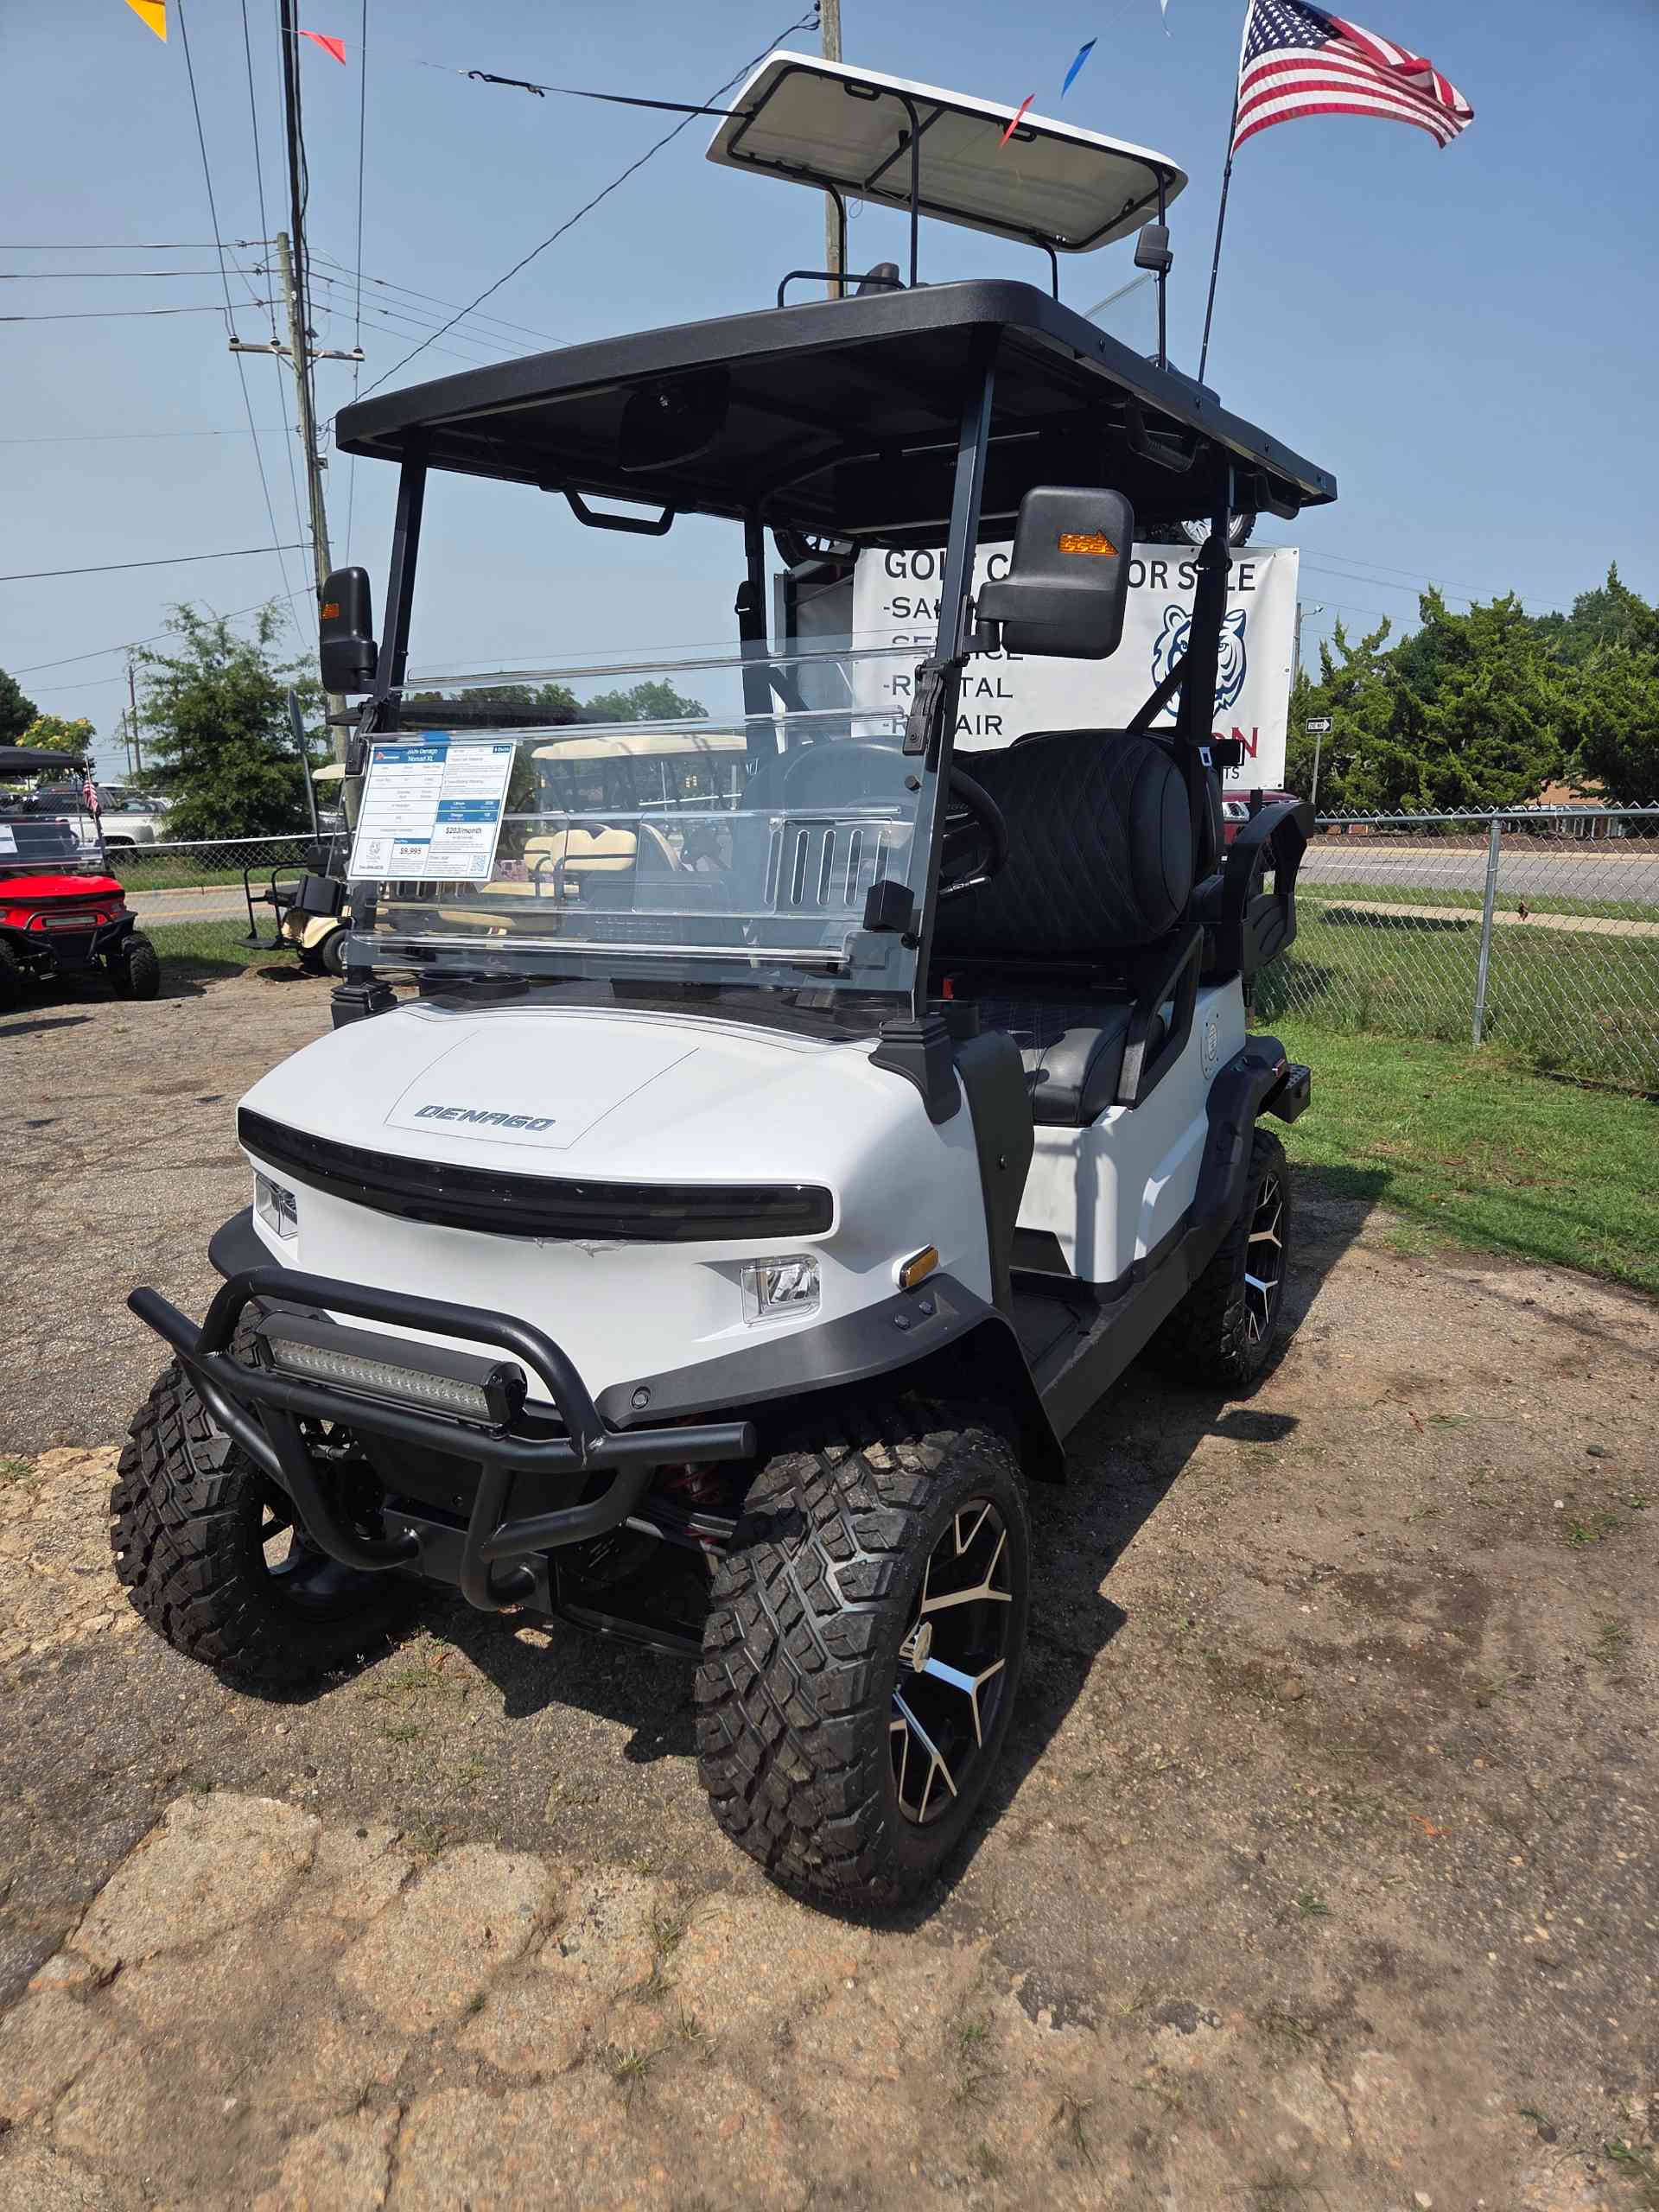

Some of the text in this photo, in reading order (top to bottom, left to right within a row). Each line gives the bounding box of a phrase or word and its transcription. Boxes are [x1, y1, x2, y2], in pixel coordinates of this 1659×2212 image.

[1126, 560, 1168, 588] OR
[1178, 561, 1255, 591] SE
[883, 675, 1014, 698] -RTAL
[882, 714, 1003, 735] -RAIR
[414, 1104, 556, 1132] DENAGO
